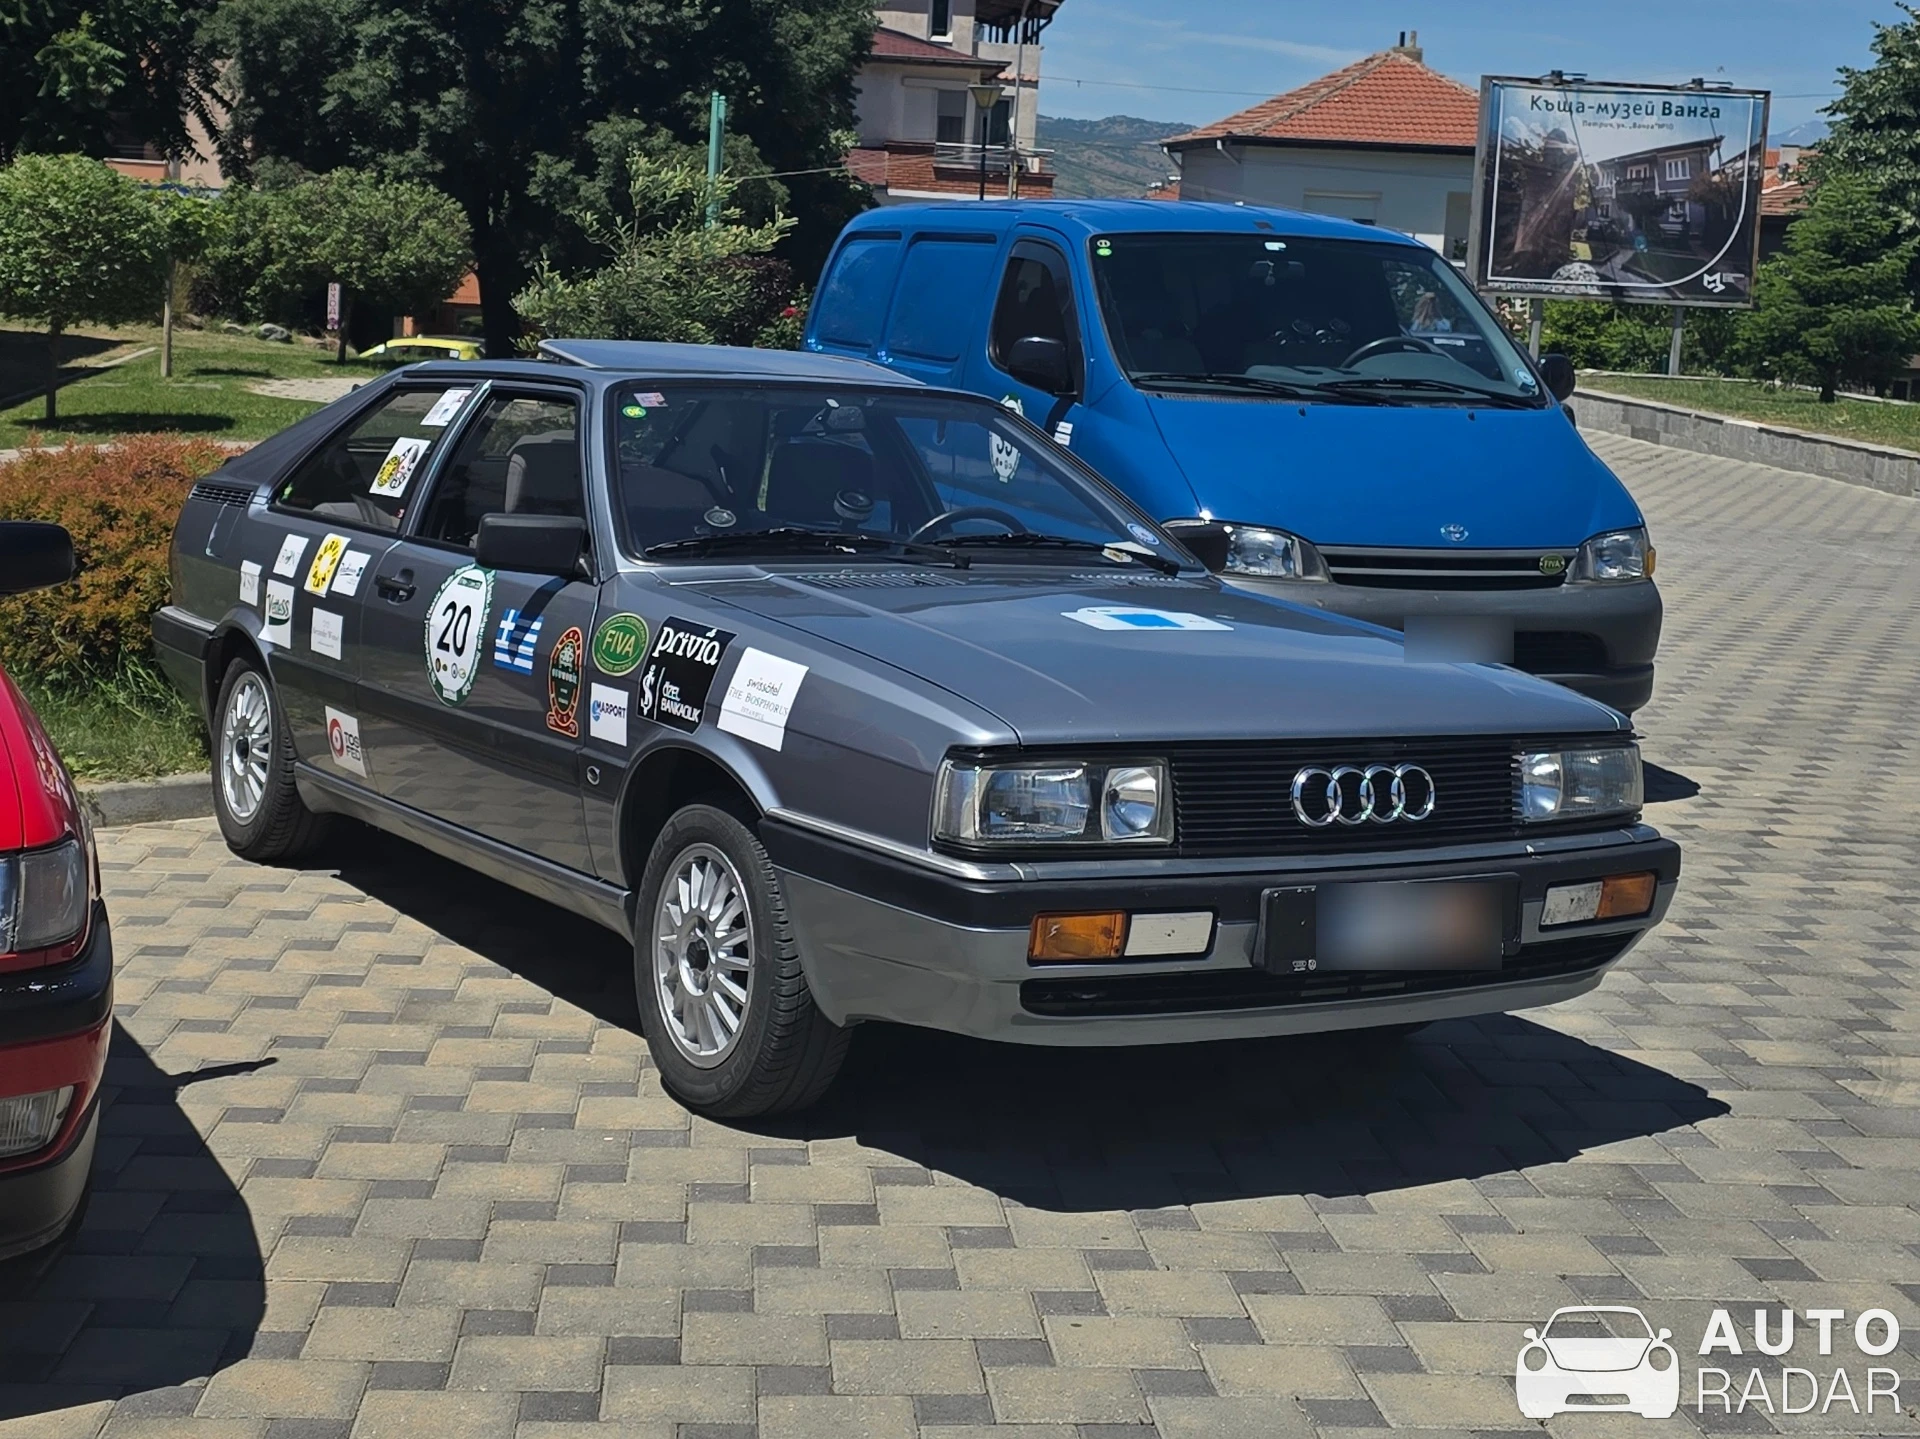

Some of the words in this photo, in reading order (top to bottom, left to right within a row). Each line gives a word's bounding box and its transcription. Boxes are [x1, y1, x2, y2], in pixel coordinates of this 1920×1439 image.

[1530, 94, 1655, 119] Къща-музей
[1661, 101, 1721, 119] Ванга
[437, 600, 472, 657] 20
[602, 629, 636, 657] FIVA
[728, 686, 744, 700] THE
[744, 693, 789, 717] BOSPHORUS
